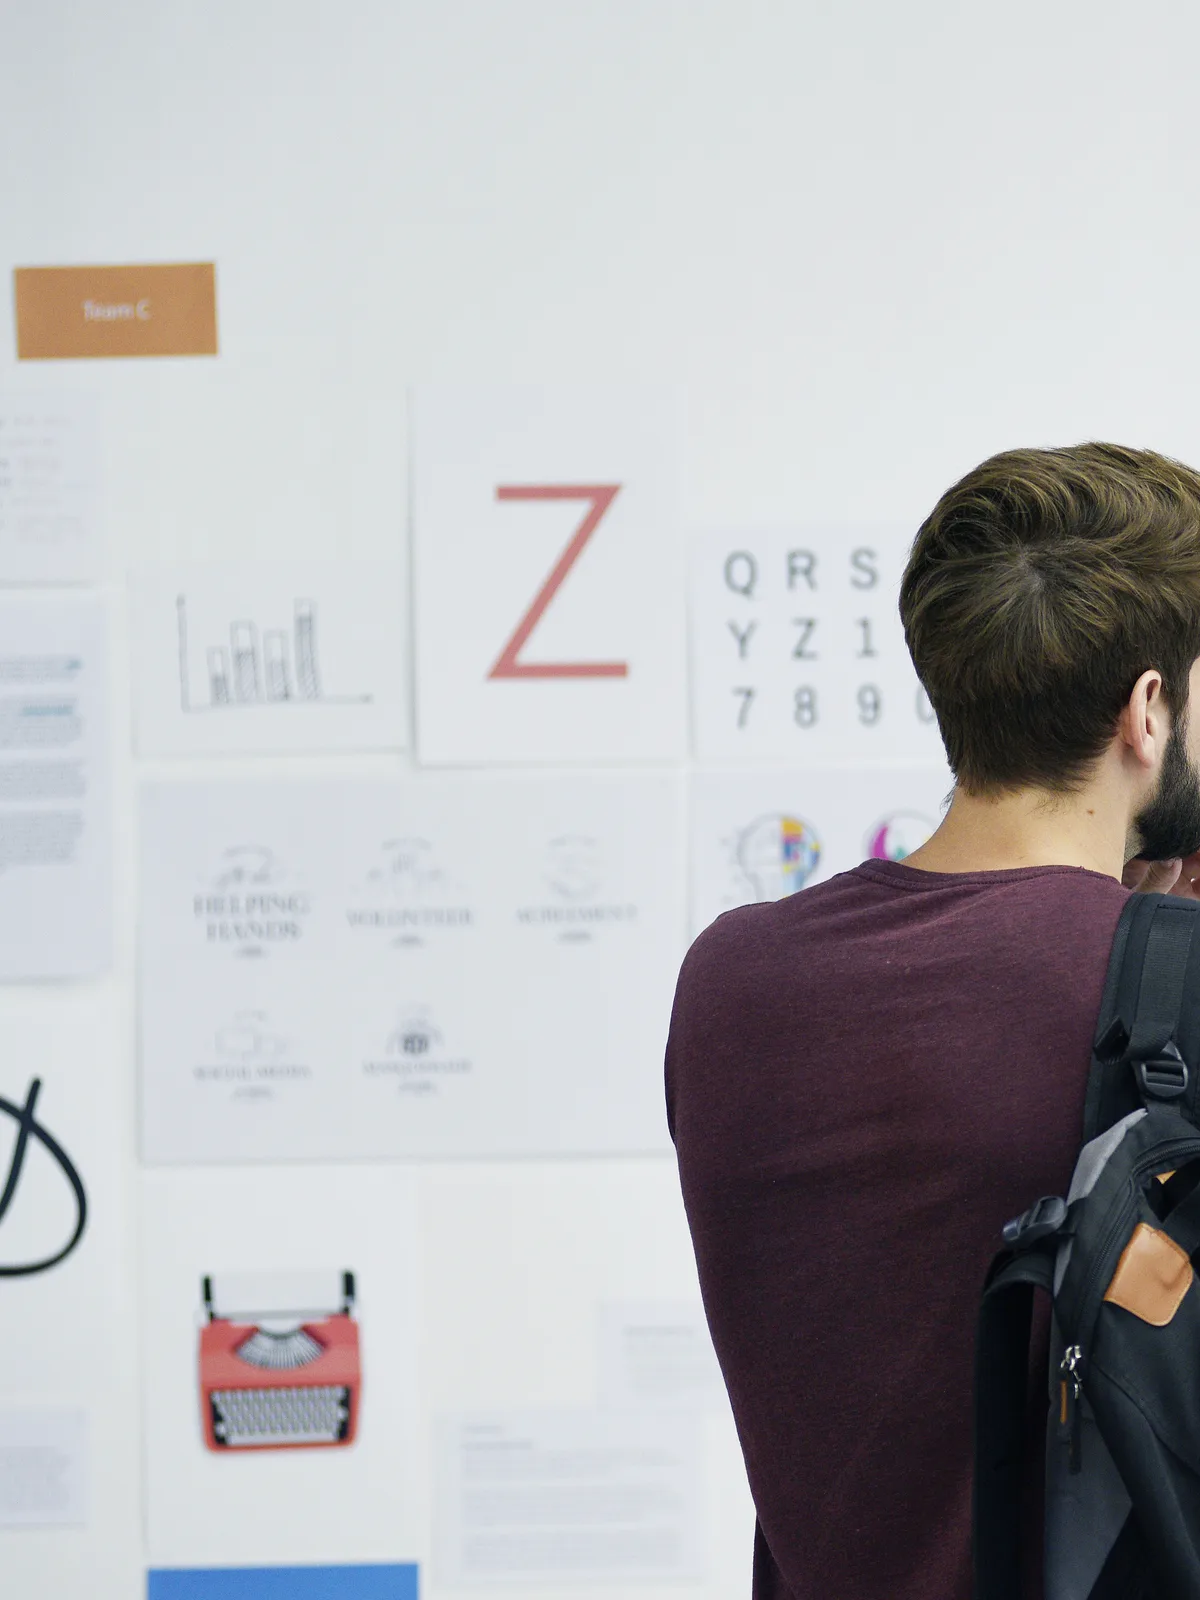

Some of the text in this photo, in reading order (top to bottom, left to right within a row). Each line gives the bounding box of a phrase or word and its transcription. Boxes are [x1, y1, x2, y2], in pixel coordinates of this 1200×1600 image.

[83, 299, 151, 321] Team C
[487, 483, 630, 682] Z
[723, 548, 878, 599] Q R S
[728, 618, 877, 660] Y Z 1
[734, 687, 755, 728] 7
[794, 686, 818, 727] 8
[856, 685, 881, 725] 9
[206, 920, 302, 942] HANDS
